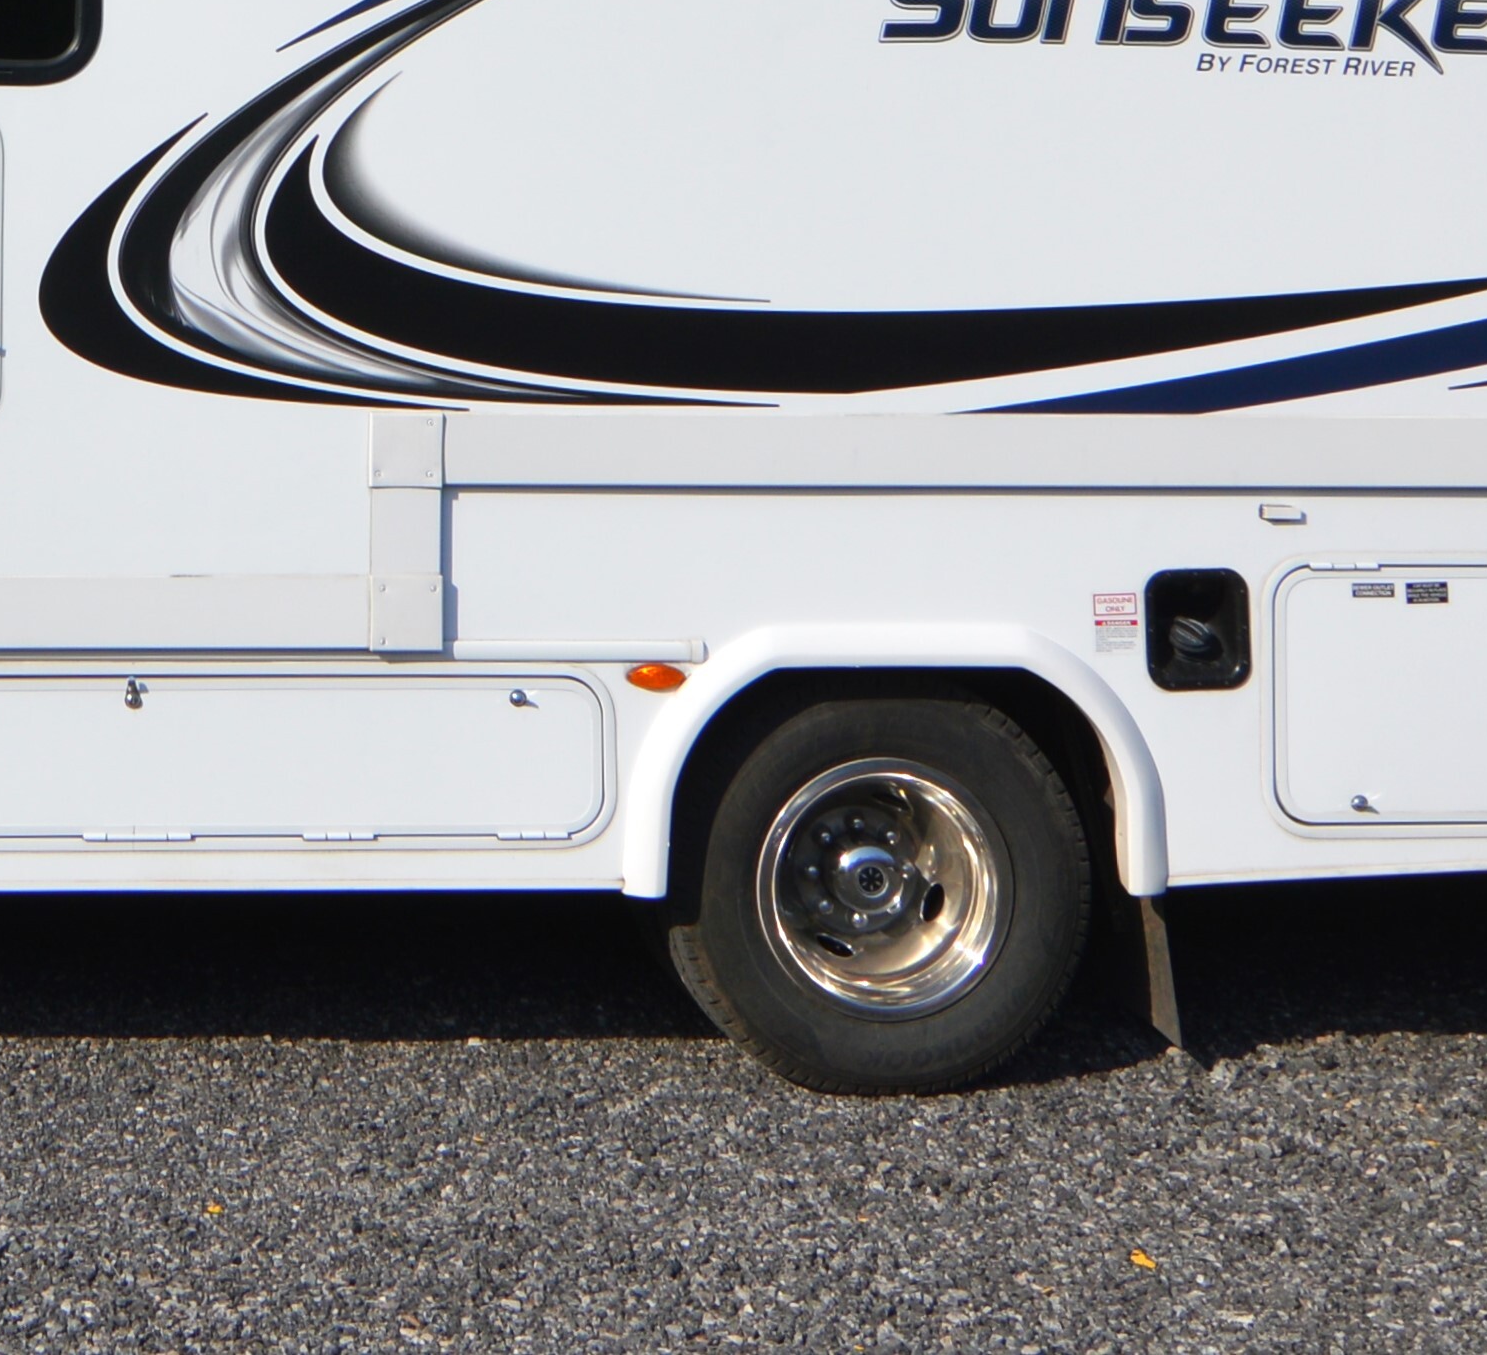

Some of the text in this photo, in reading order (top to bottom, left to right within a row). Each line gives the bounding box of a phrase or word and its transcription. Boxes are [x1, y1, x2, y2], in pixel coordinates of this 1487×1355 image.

[1196, 52, 1416, 77] BY FOREST RIVER
[1096, 597, 1133, 605] GASOLINE
